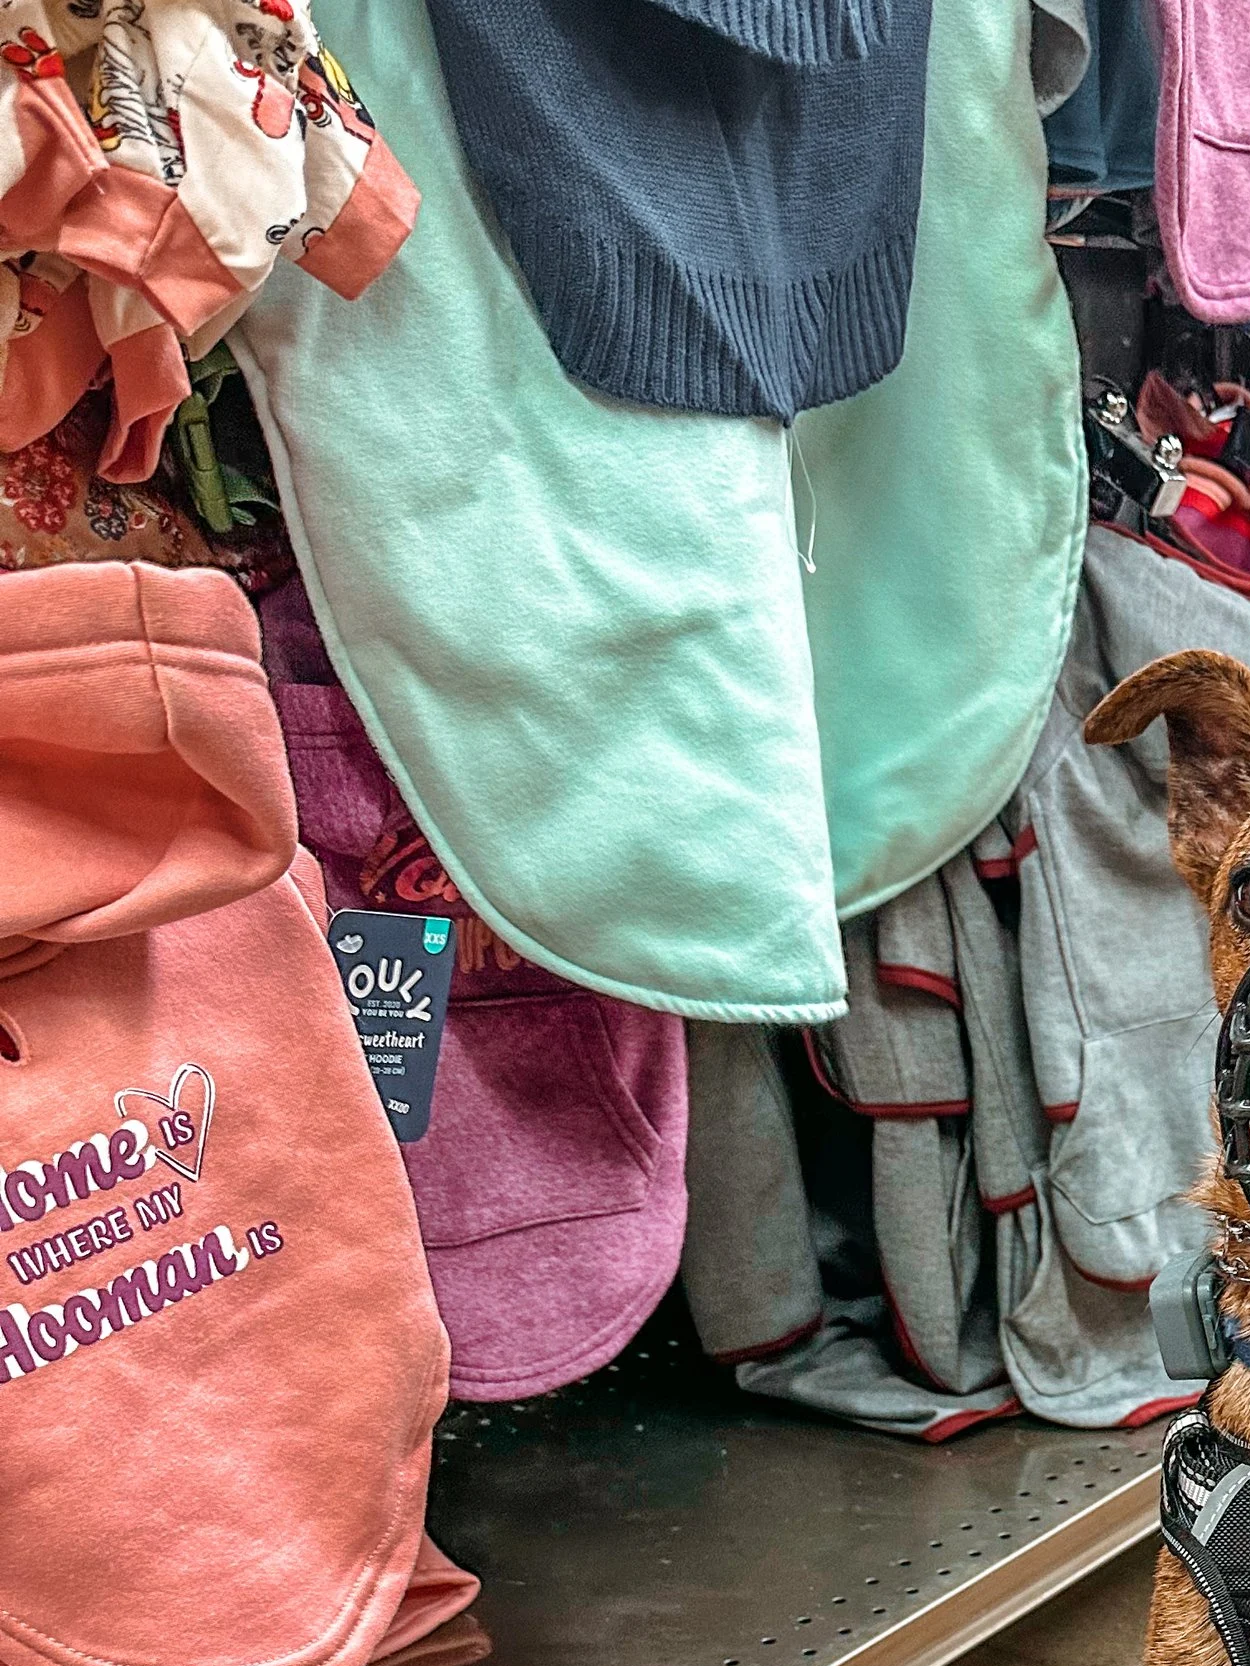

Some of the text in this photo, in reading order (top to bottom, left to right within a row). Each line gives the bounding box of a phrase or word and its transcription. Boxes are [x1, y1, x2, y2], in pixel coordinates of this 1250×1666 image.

[424, 932, 446, 945] XXS
[348, 958, 432, 1022] OULY
[369, 1054, 402, 1064] HOODIE
[159, 1111, 195, 1150] IS
[7, 1182, 183, 1285] WHERE MY
[246, 1221, 284, 1259] IS
